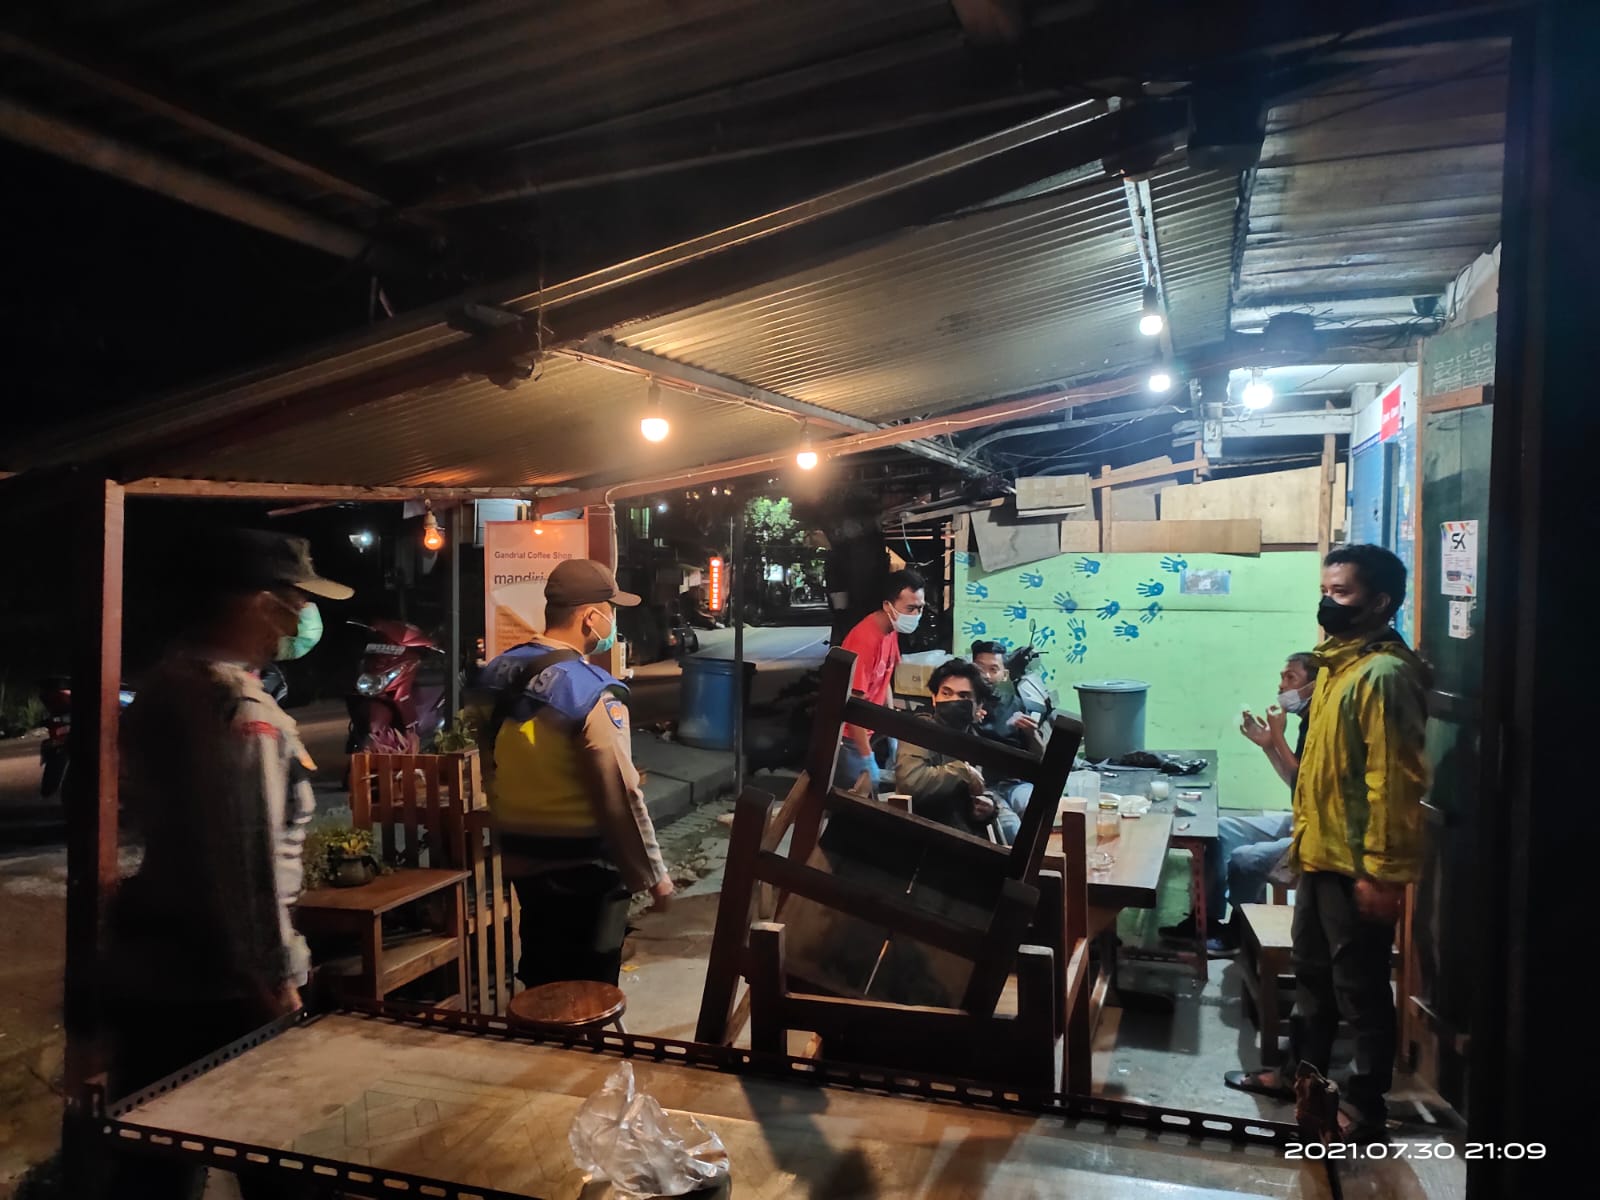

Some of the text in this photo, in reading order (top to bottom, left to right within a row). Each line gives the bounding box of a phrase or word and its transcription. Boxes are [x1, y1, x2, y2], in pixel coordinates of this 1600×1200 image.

[527, 551, 551, 559] Coffee
[553, 551, 573, 561] Shop
[494, 571, 545, 585] mandiri
